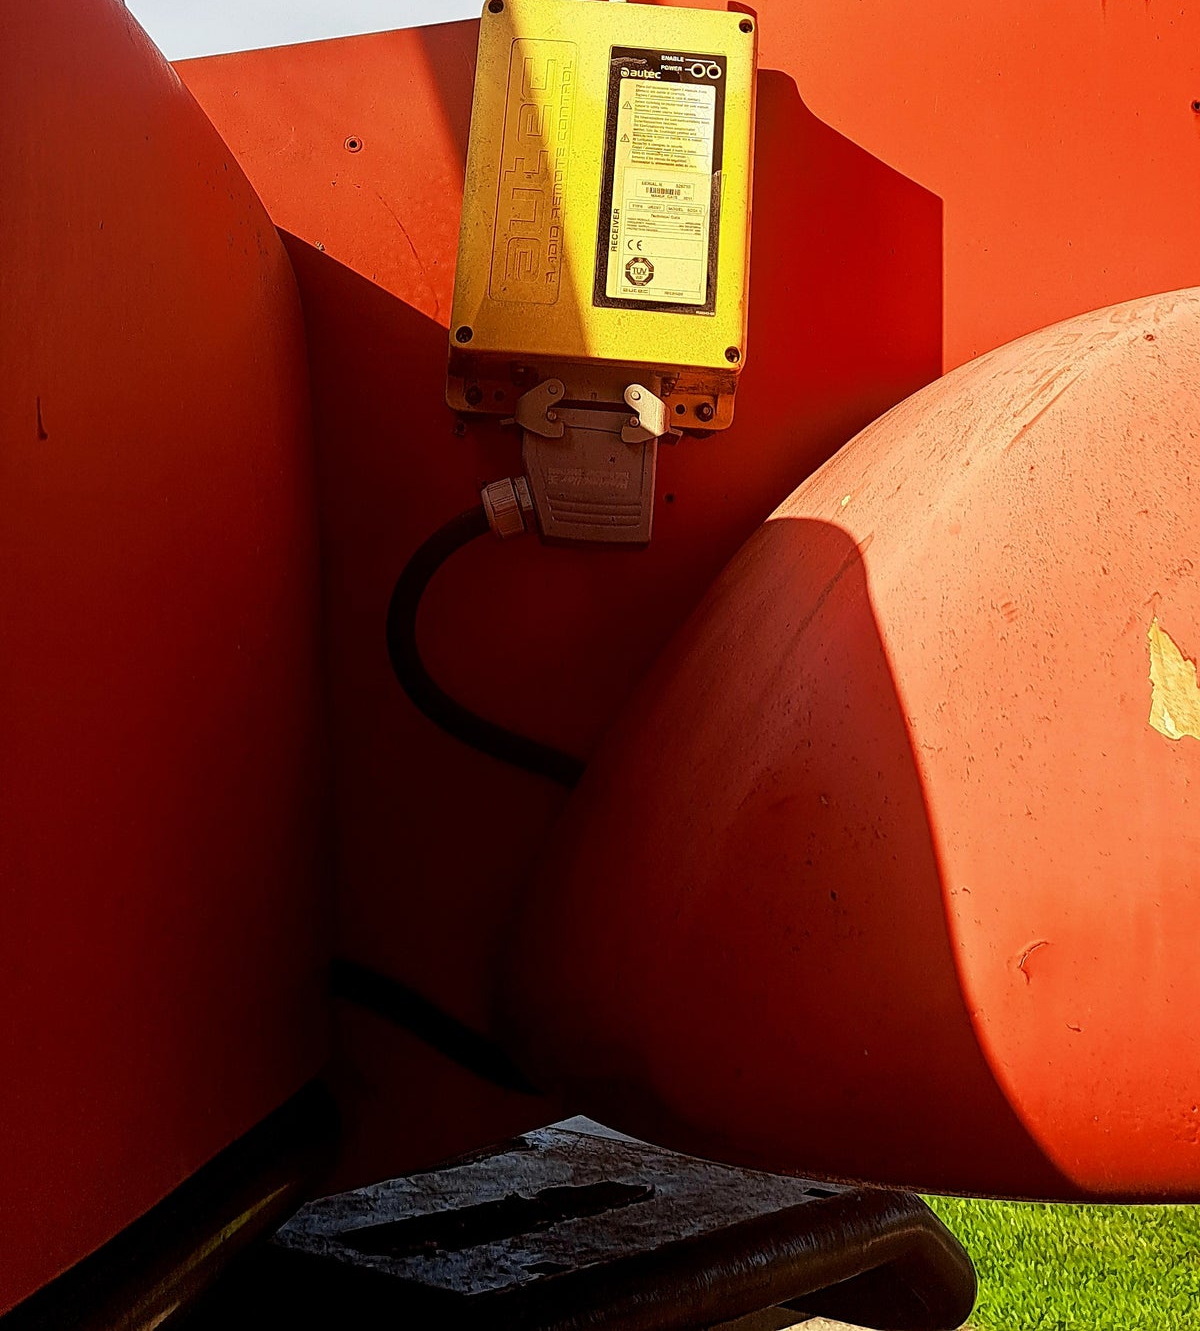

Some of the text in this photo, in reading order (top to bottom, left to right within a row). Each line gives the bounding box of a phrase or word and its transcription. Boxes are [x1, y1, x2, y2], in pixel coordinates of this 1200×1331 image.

[630, 68, 662, 79] autec
[660, 64, 683, 72] POWER
[661, 55, 685, 63] ENABLE
[557, 59, 573, 141] CONTROL
[503, 56, 557, 284] autec
[550, 146, 567, 218] REMOTE
[610, 208, 620, 252] RECEIVER
